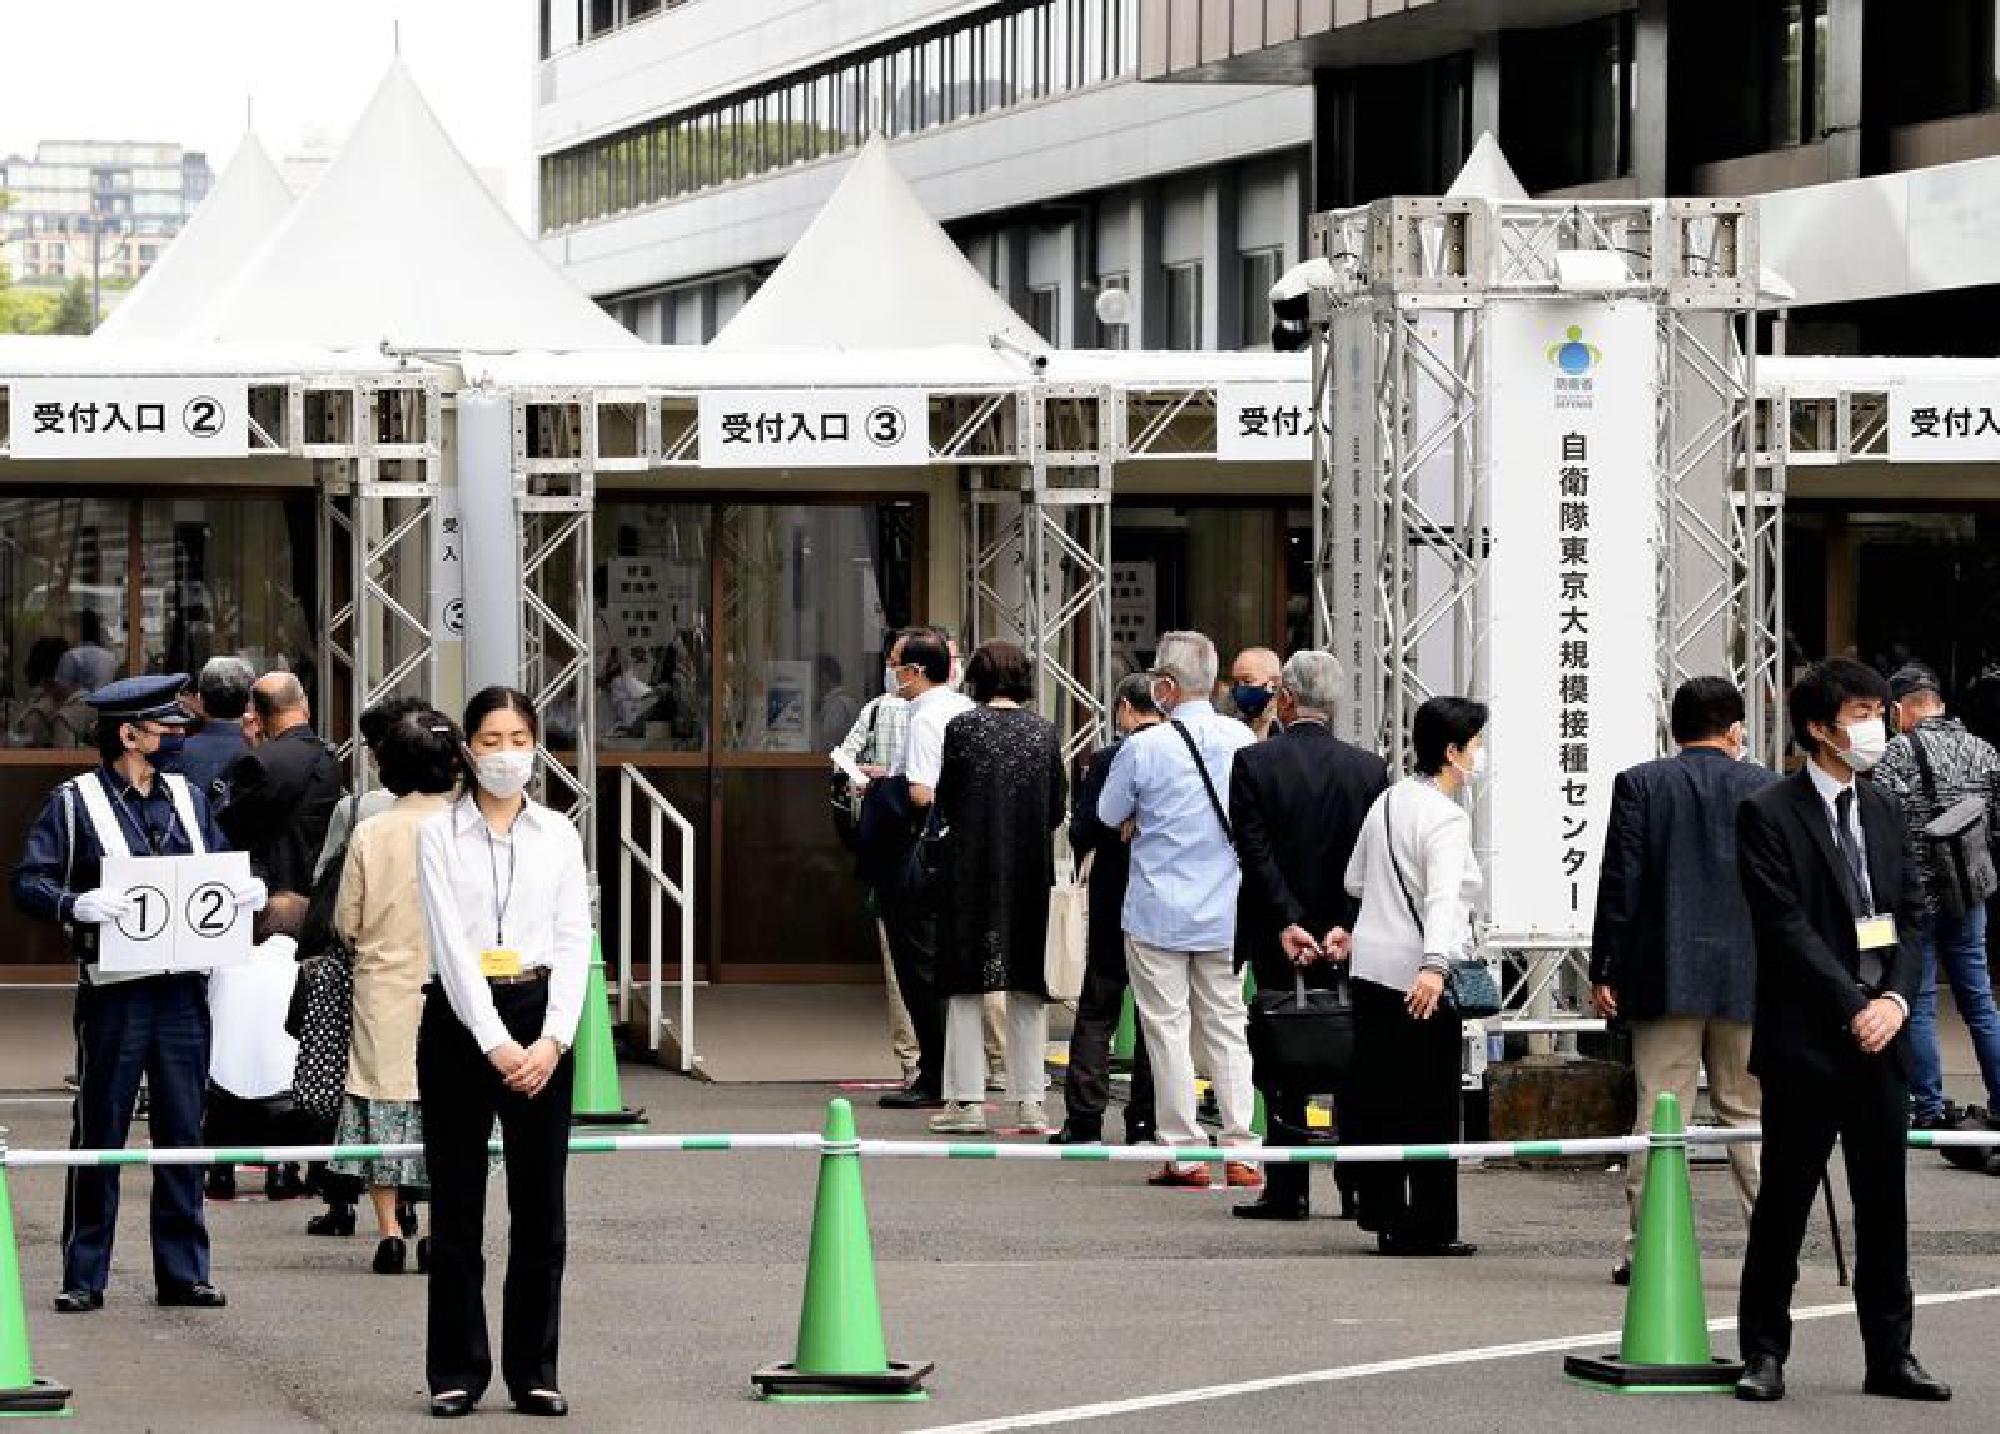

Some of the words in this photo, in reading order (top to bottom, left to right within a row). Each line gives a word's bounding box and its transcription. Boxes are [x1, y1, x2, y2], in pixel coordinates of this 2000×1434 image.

[33, 402, 166, 434] 受付入口
[721, 412, 850, 444] 受付入口
[1911, 406, 2000, 438] 受付入
[1559, 430, 1590, 911] 自衛隊東京大規模接種センター
